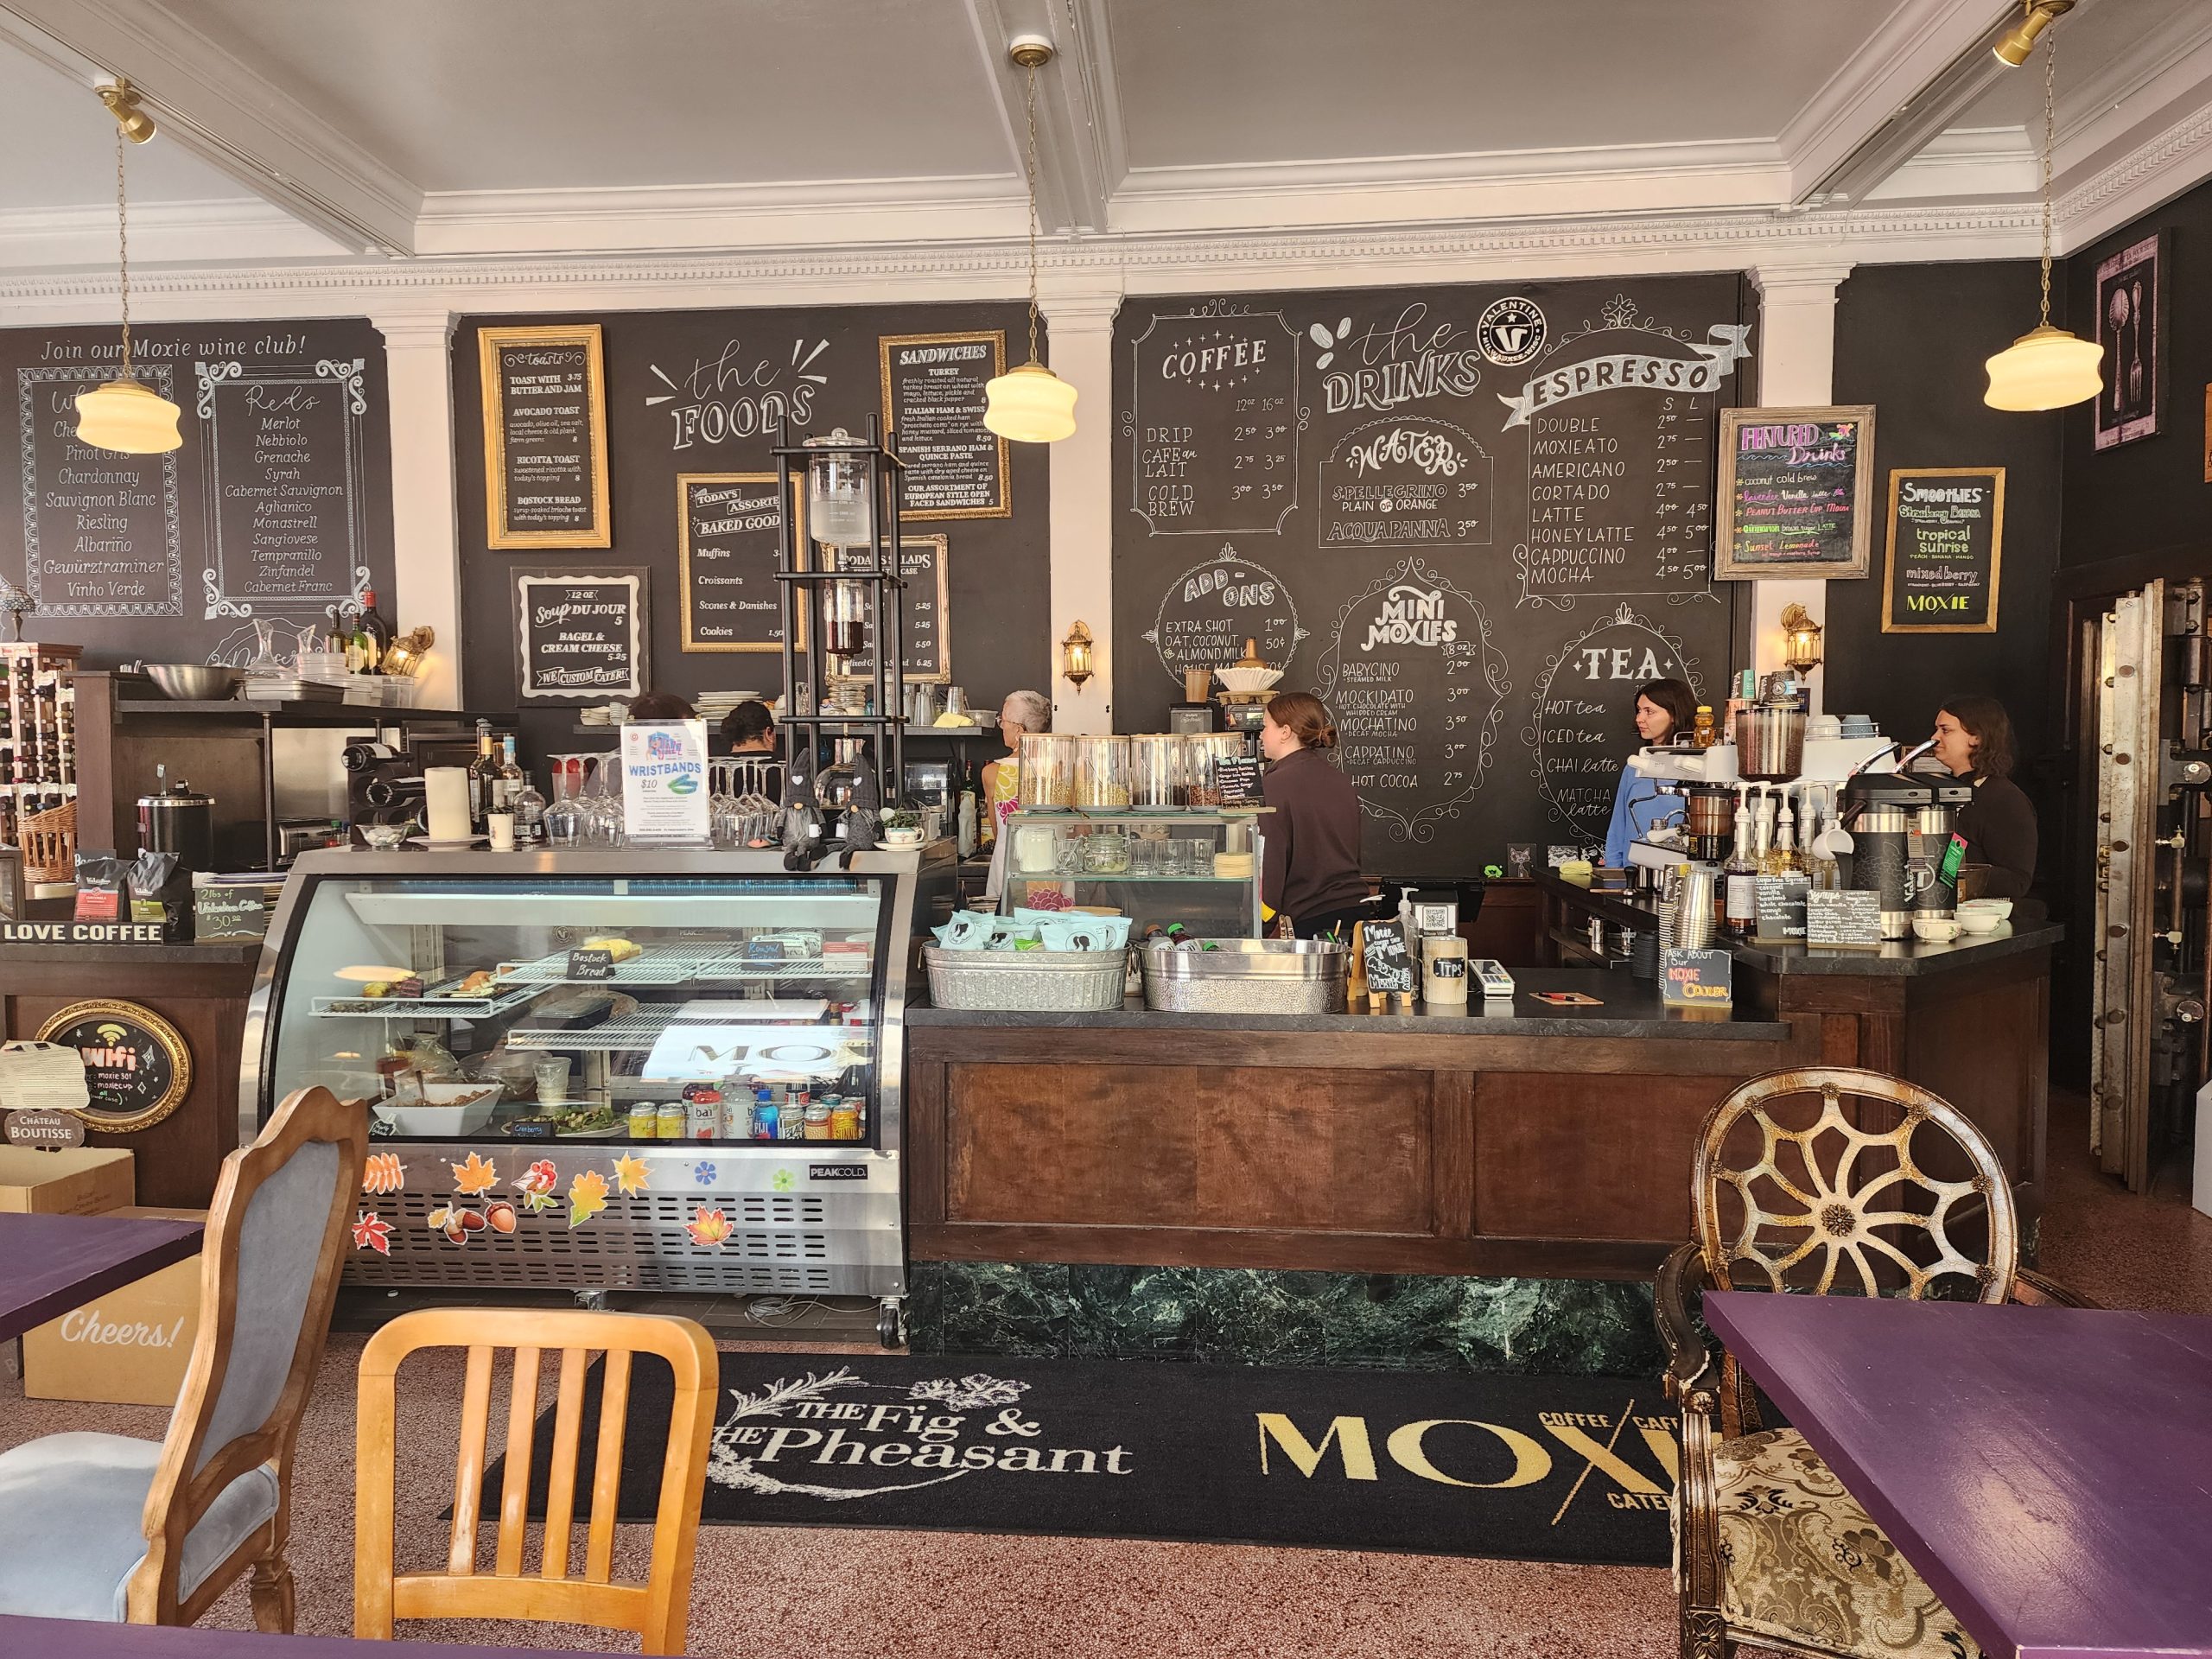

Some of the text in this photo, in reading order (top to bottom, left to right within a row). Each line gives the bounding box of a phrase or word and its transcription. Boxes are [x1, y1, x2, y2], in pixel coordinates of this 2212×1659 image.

[1481, 302, 1542, 328] VALENTINE
[1348, 302, 1468, 365] the
[41, 336, 305, 360] Join our Moxie wine club!
[899, 346, 987, 365] SANDWICHES
[525, 353, 563, 365] toasts
[1163, 340, 1266, 379] COFFEE
[684, 340, 780, 399] the
[510, 375, 561, 385] TOAST WITH
[1323, 349, 1481, 413] DRINKS
[1533, 359, 1707, 407] ESPRESSO
[245, 386, 320, 416] Reds
[261, 417, 300, 430] Merlot
[671, 385, 815, 450] FOODS
[1538, 418, 1600, 434] DOUBLE
[256, 435, 307, 448] Nebbiolo
[1147, 427, 1193, 442] DRIP
[1742, 424, 1819, 451] FEATURED
[65, 445, 99, 461] Pinot
[1351, 429, 1458, 478] WATER
[1533, 438, 1618, 454] MOXIEATO
[1785, 443, 1846, 464] Drinks
[255, 451, 310, 464] Grenache
[1142, 448, 1181, 463] CAFE
[59, 468, 139, 486] Chardonnay
[265, 468, 300, 480] Syrah
[1145, 462, 1186, 477] LAIT
[1532, 461, 1624, 478] AMERICANO
[1745, 473, 1816, 485] coconut cold brew
[226, 483, 343, 499] Cabernet Sauvignon
[698, 491, 738, 504] TODAY'S
[1149, 485, 1193, 501] COLD
[1532, 485, 1610, 501] CORTADO
[46, 491, 156, 511] Sauvignon Blanc
[255, 501, 312, 514] Aglianico
[1148, 501, 1195, 516] BREW
[1343, 500, 1374, 512] PLAIN
[1396, 499, 1438, 510] ORANGE
[1532, 507, 1585, 522] LATTE
[76, 515, 128, 532] Riesling
[252, 516, 318, 529] Monastrell
[701, 520, 742, 534] BAKED
[1327, 518, 1451, 542] ACQUA PANNA
[253, 533, 318, 547] Sangiovese
[1532, 527, 1635, 543] HONEY LATTE
[1917, 525, 1970, 542] tropical
[74, 537, 132, 553] Albariño
[1745, 541, 1772, 552] Sunset
[1779, 540, 1819, 550] Lemonade
[1920, 542, 1969, 553] sunrise
[251, 550, 321, 563] Tempranillo
[696, 549, 730, 559] Muffins
[1531, 548, 1625, 566] CAPPUCCINO
[44, 560, 164, 575] Gewürztraminer
[259, 566, 315, 579] Zinfandel
[1531, 566, 1595, 584] MOCHA
[1906, 566, 1977, 583] mixed berry
[245, 580, 332, 593] Cabernet Franc
[698, 576, 743, 585] Croissants
[68, 581, 145, 597] Vinho Verde
[699, 601, 728, 610] Scones
[739, 601, 777, 610] Danishes
[1375, 586, 1445, 625] MINI
[1907, 594, 1969, 614] MOXIE
[536, 603, 626, 624] Soup DU JOUR
[614, 616, 622, 625] 5
[700, 627, 733, 636] Cookies
[1166, 620, 1233, 632] EXTRA SHOT
[559, 632, 594, 641] BAGEL
[1360, 620, 1458, 652] MOXIES
[541, 644, 622, 653] CREAM CHEESE
[1177, 647, 1246, 661] ALMOND MILK
[1343, 662, 1400, 677] BABYCINO
[1582, 647, 1666, 680] TEA
[543, 671, 625, 683] WE CUSTOM CATER!
[1336, 690, 1414, 704] MOCKIDATO
[1545, 701, 1606, 715] HOT tea
[1340, 717, 1417, 731] MOCHATINO
[1542, 729, 1606, 744] ICED tea
[1344, 746, 1414, 759] CAPPATINO
[629, 762, 701, 776] WRISTBANDS
[1547, 757, 1619, 772] CHAI latte
[641, 779, 658, 789] $10
[1351, 774, 1418, 787] HOT COCOA
[1557, 788, 1611, 803] MATCHA
[1567, 803, 1611, 817] latte
[200, 888, 234, 899] 2lbs of
[4, 925, 161, 941] LOVE COFFEE
[573, 952, 607, 963] Bostock
[575, 965, 606, 976] Bread
[1669, 968, 1700, 982] MOXIE
[696, 1105, 713, 1117] bai
[10, 1127, 72, 1140] BOUTISSE
[754, 1121, 766, 1134] FIJI
[60, 1310, 184, 1348] Cheers!
[797, 1402, 1042, 1444] THE Fig &
[1538, 1412, 1611, 1428] COFFEE
[756, 1427, 1134, 1476] Pheasant
